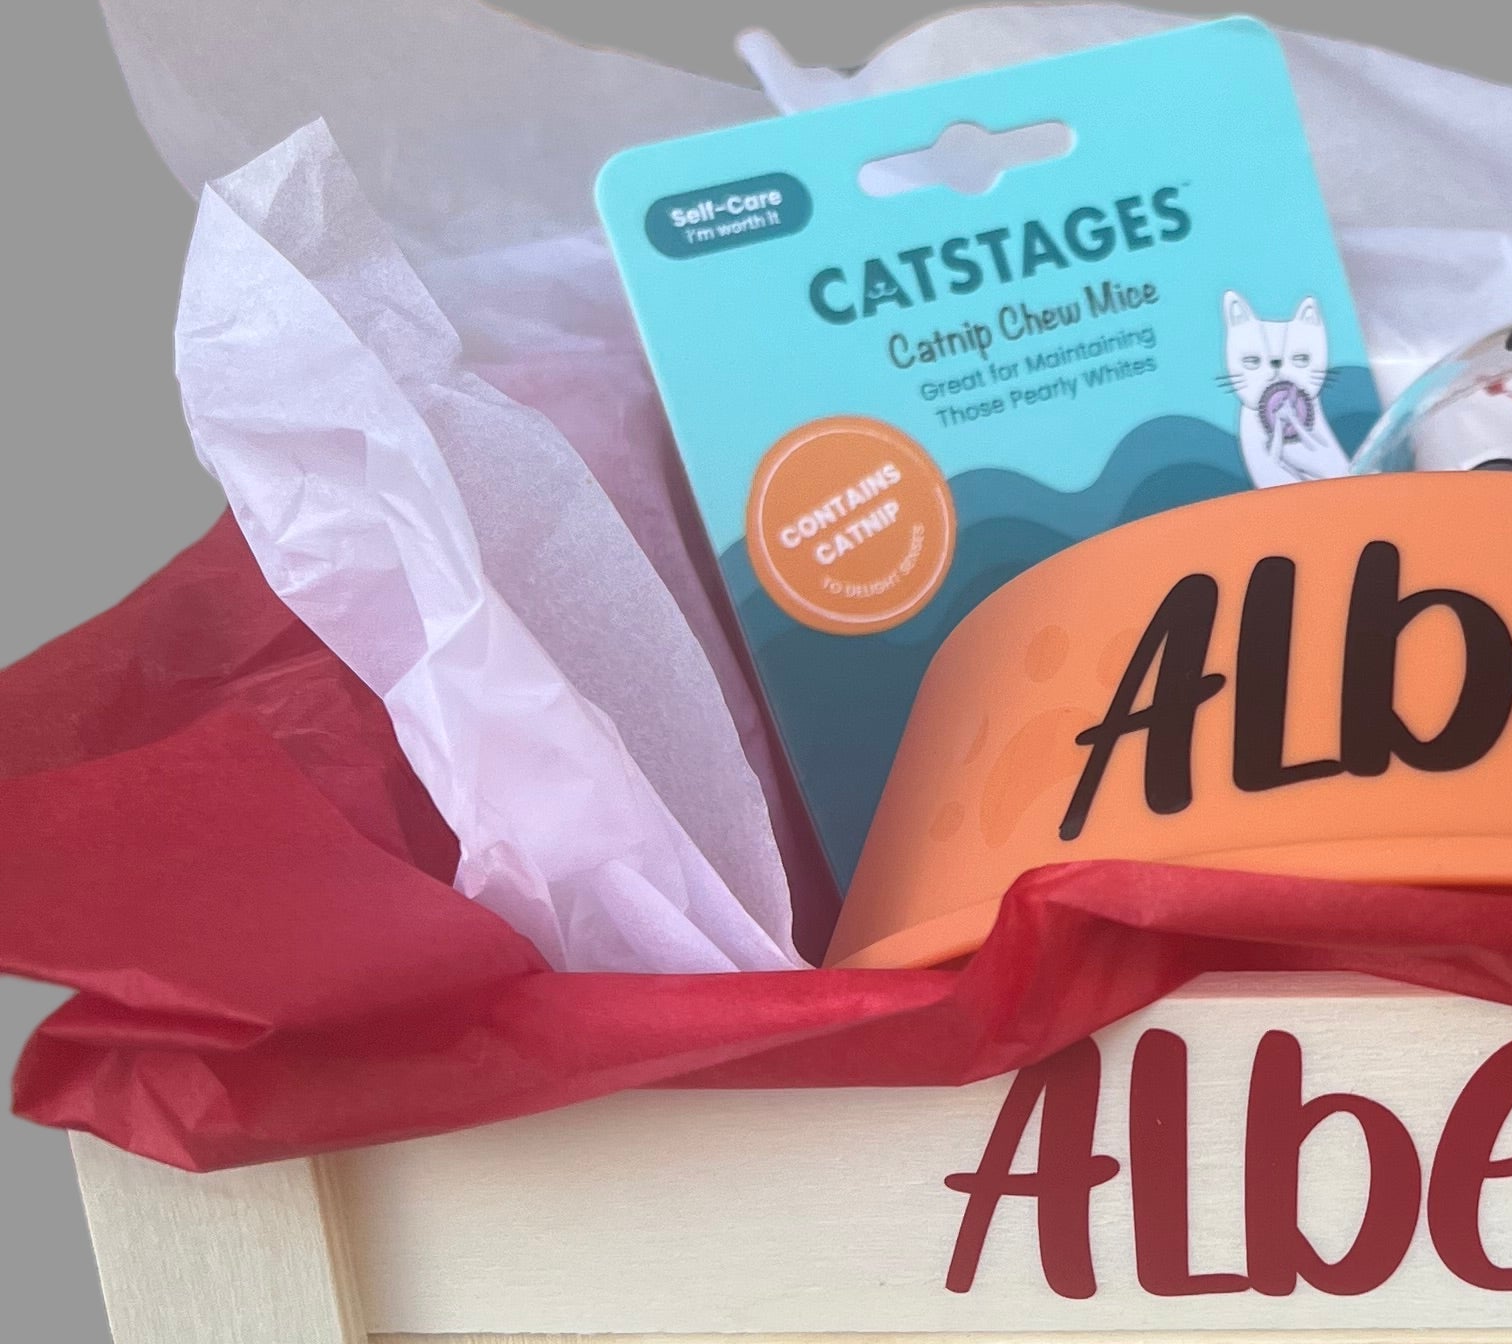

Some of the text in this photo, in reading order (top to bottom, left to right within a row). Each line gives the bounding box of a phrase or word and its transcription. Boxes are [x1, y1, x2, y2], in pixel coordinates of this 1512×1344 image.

[671, 190, 782, 227] Self-Care
[716, 215, 767, 238] worth
[767, 209, 780, 225] it
[808, 186, 1193, 326] CATSTAGES
[888, 279, 1161, 370] Catnip Chew Mice
[919, 323, 1157, 403] Great for Maintaining
[935, 355, 1158, 429] Those Pearly Whites
[779, 462, 902, 549] CONTAINS
[814, 500, 901, 566] CATNIP
